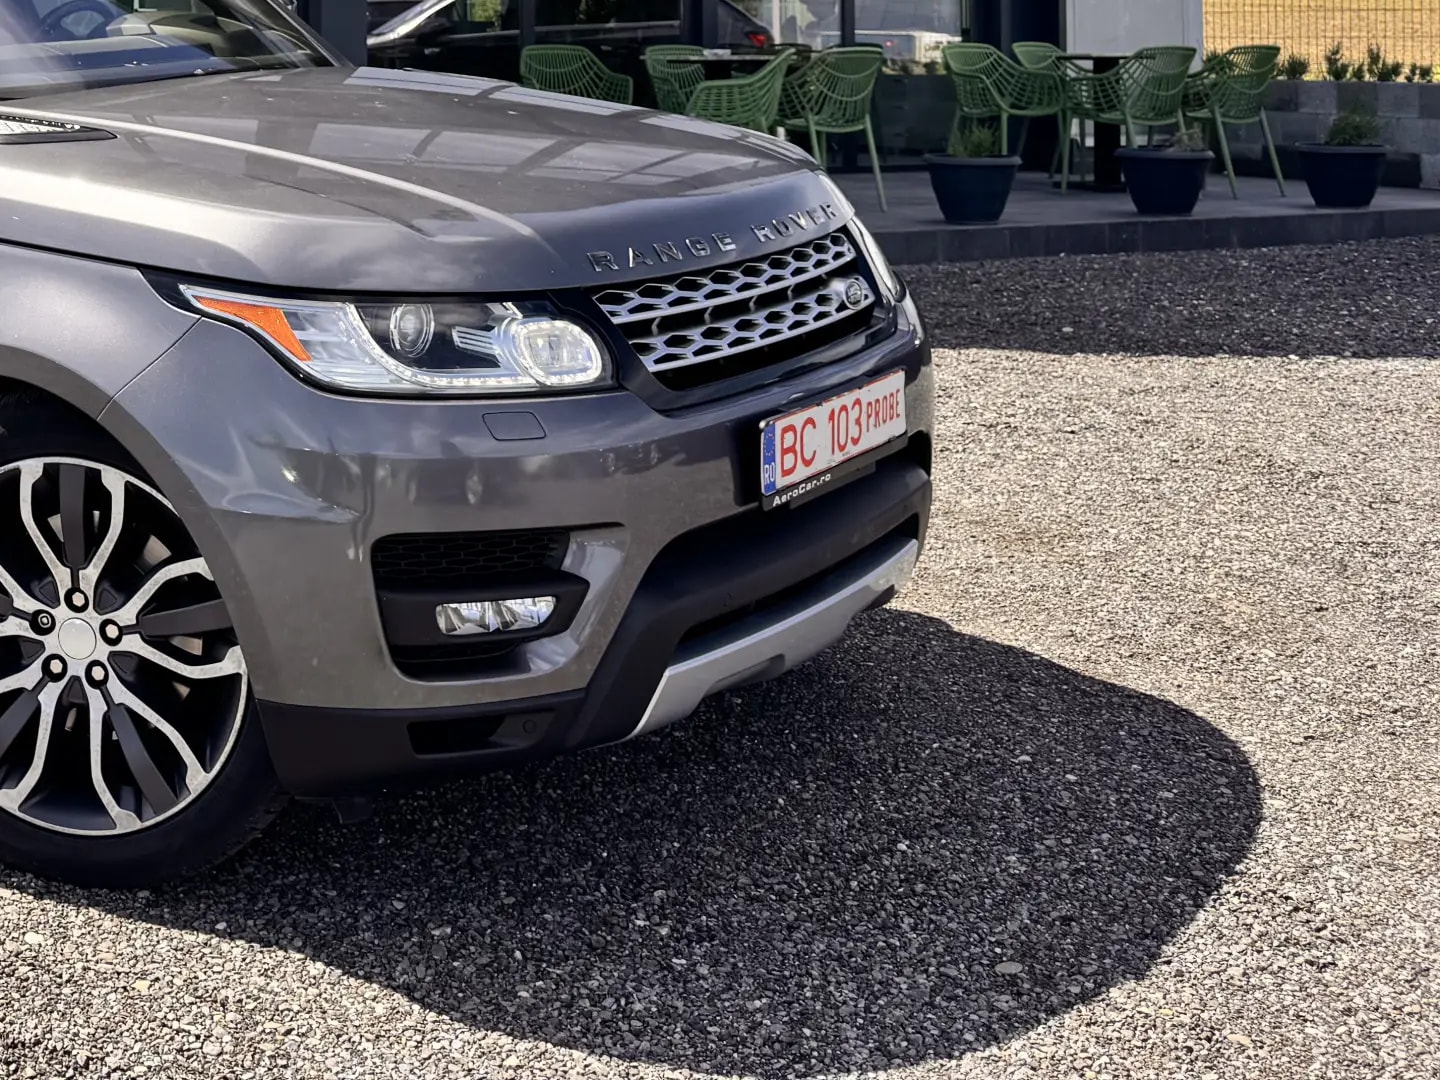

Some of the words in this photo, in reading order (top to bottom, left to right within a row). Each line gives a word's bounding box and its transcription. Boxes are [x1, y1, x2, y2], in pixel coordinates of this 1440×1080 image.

[586, 231, 737, 272] RANGE
[750, 201, 840, 243] ROVER
[780, 417, 817, 478] BC
[828, 397, 863, 456] 103
[866, 388, 901, 433] PROBE
[764, 461, 776, 485] RO
[772, 473, 832, 508] AeroCar.ro
